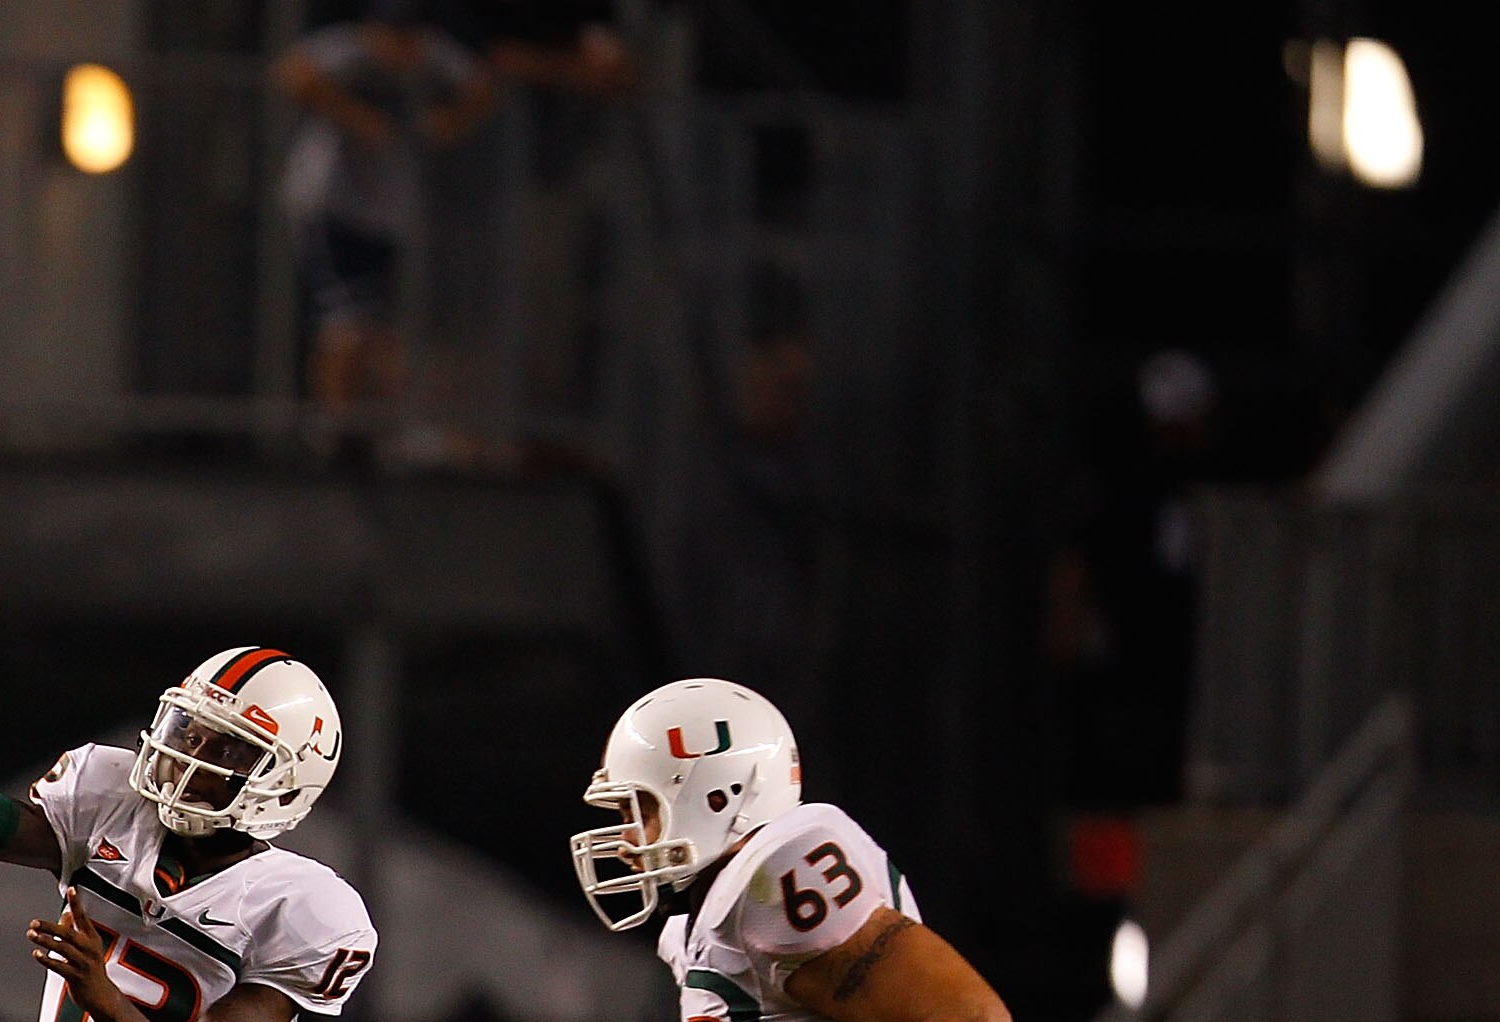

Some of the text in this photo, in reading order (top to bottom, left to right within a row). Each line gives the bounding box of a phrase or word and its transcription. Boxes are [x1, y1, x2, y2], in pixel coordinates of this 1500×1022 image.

[667, 720, 732, 759] U
[145, 899, 167, 918] U
[780, 841, 862, 932] 63
[317, 947, 371, 999] 12
